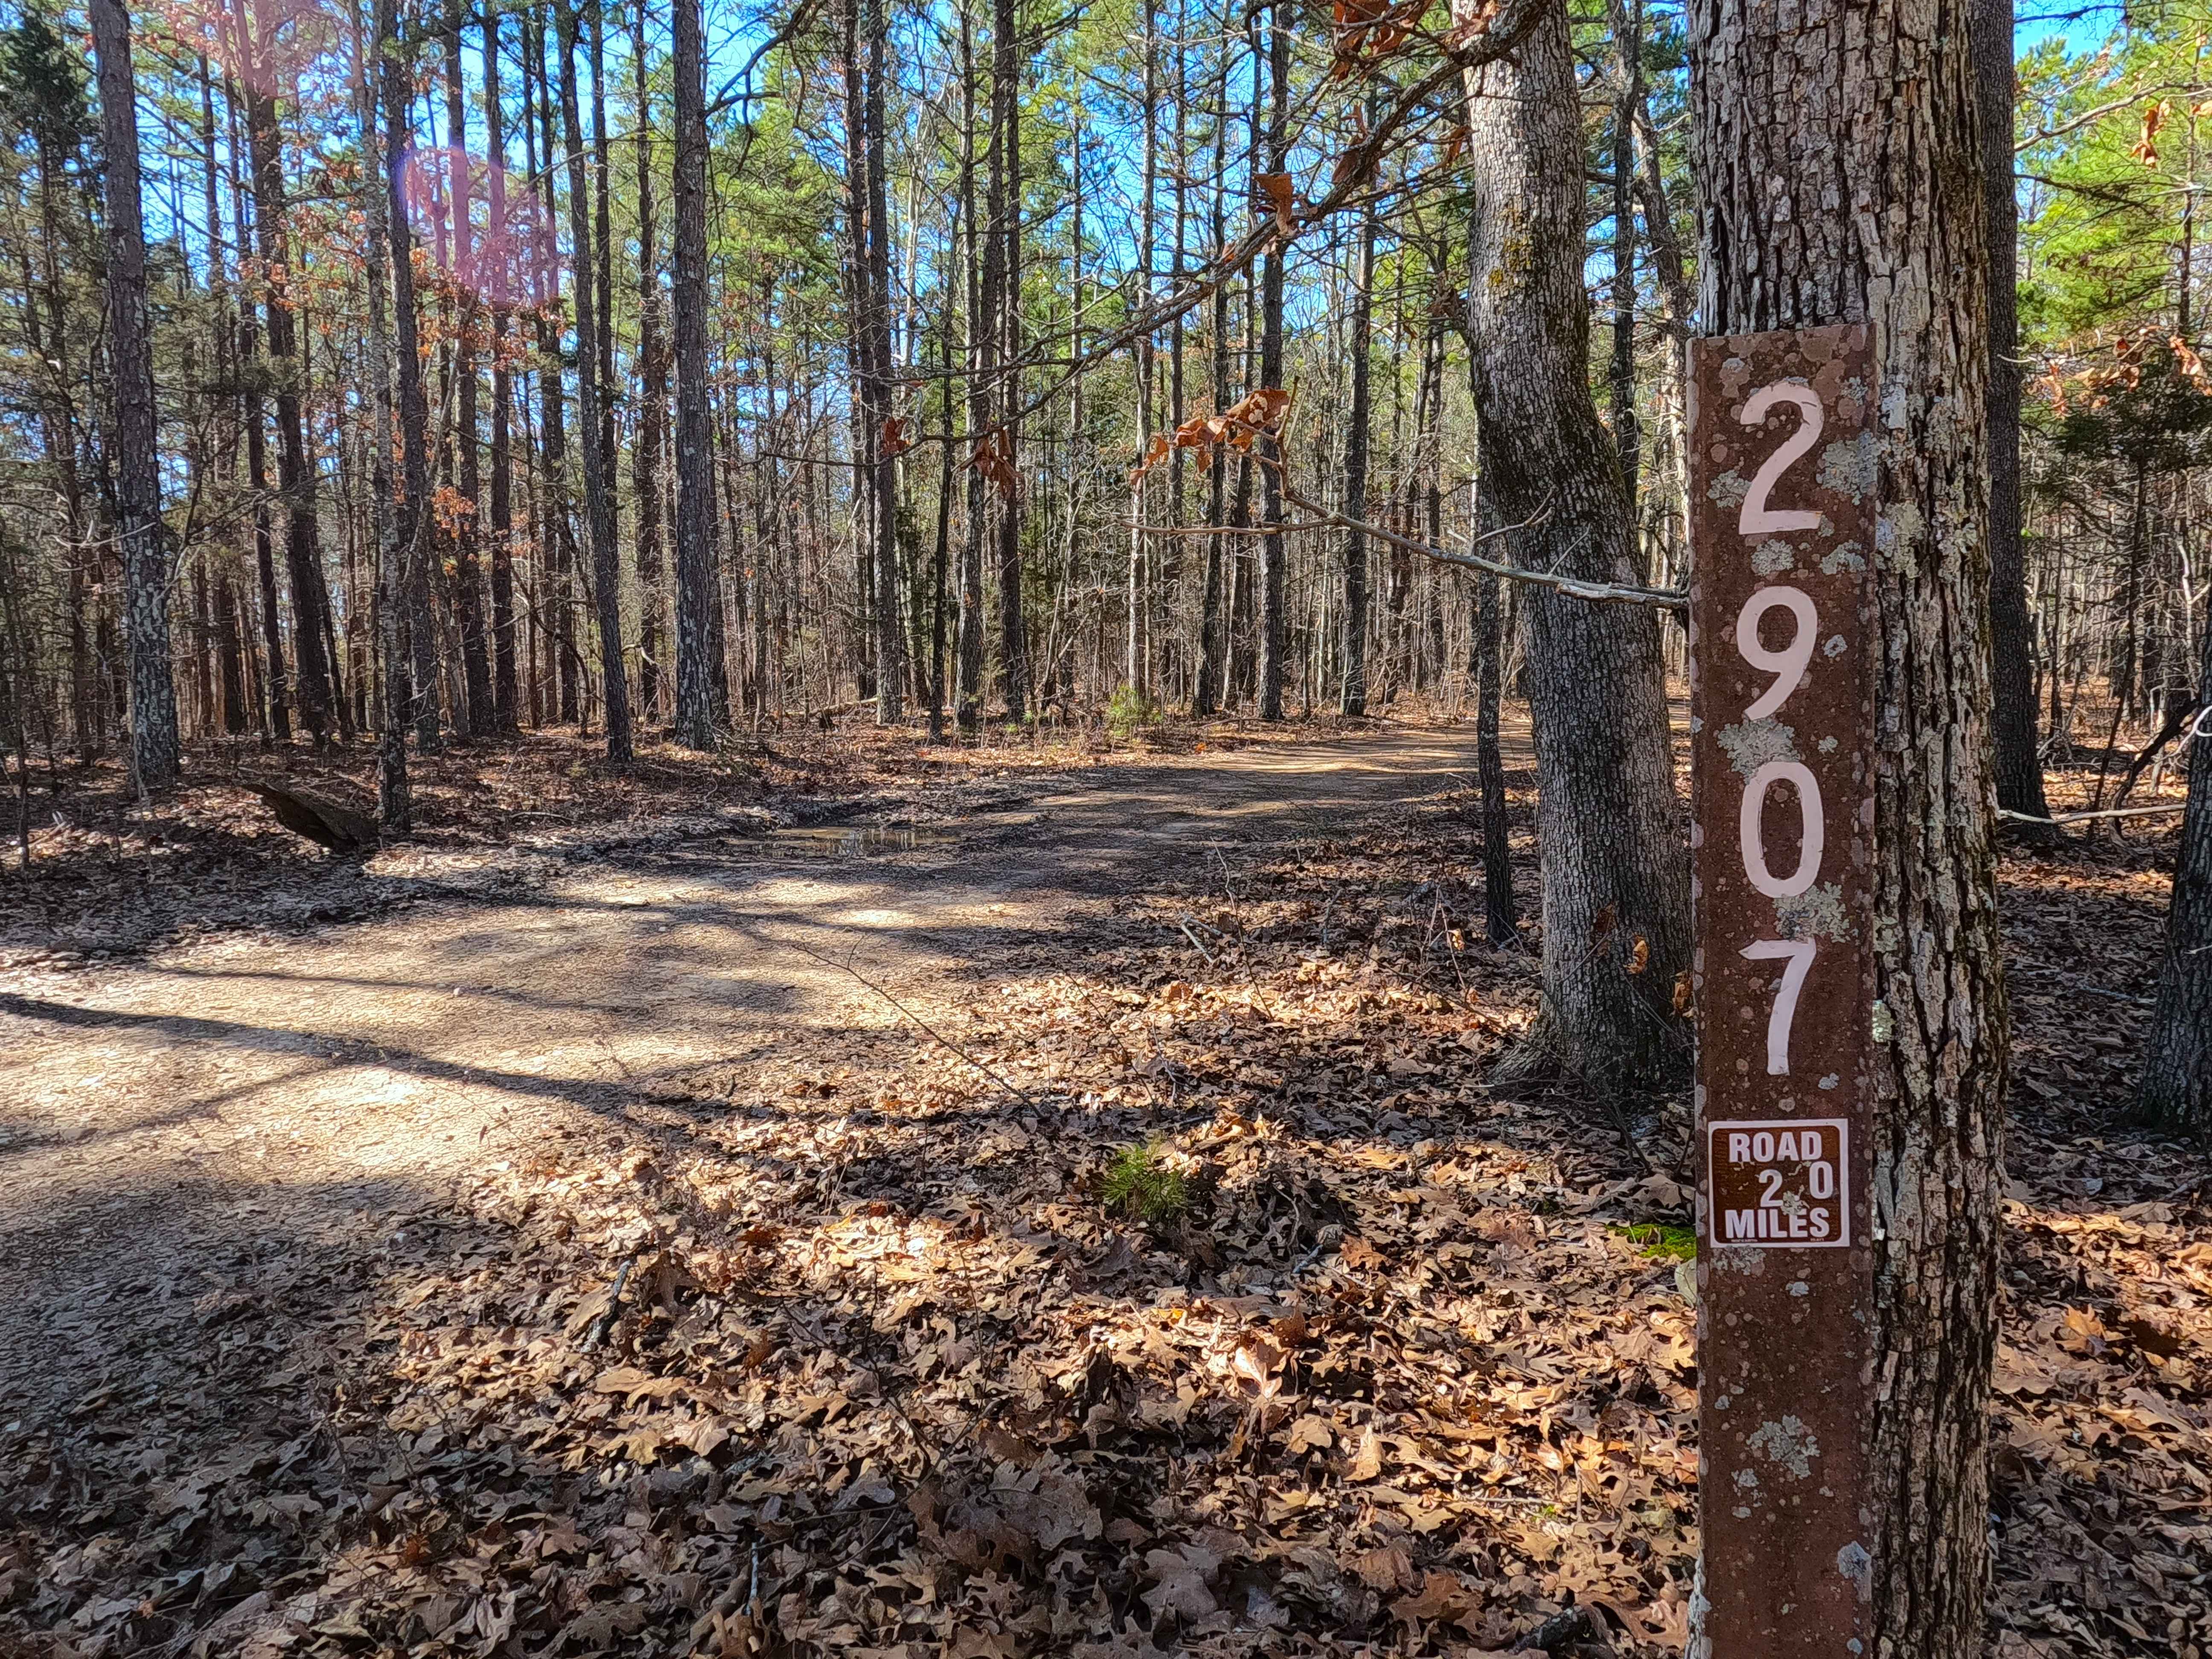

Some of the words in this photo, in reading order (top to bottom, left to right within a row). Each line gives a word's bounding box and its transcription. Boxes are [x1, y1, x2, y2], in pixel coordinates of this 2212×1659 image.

[1736, 381, 1825, 1076] 2907
[1729, 1131, 1822, 1163] ROAD
[1725, 1207, 1830, 1238] MILES
